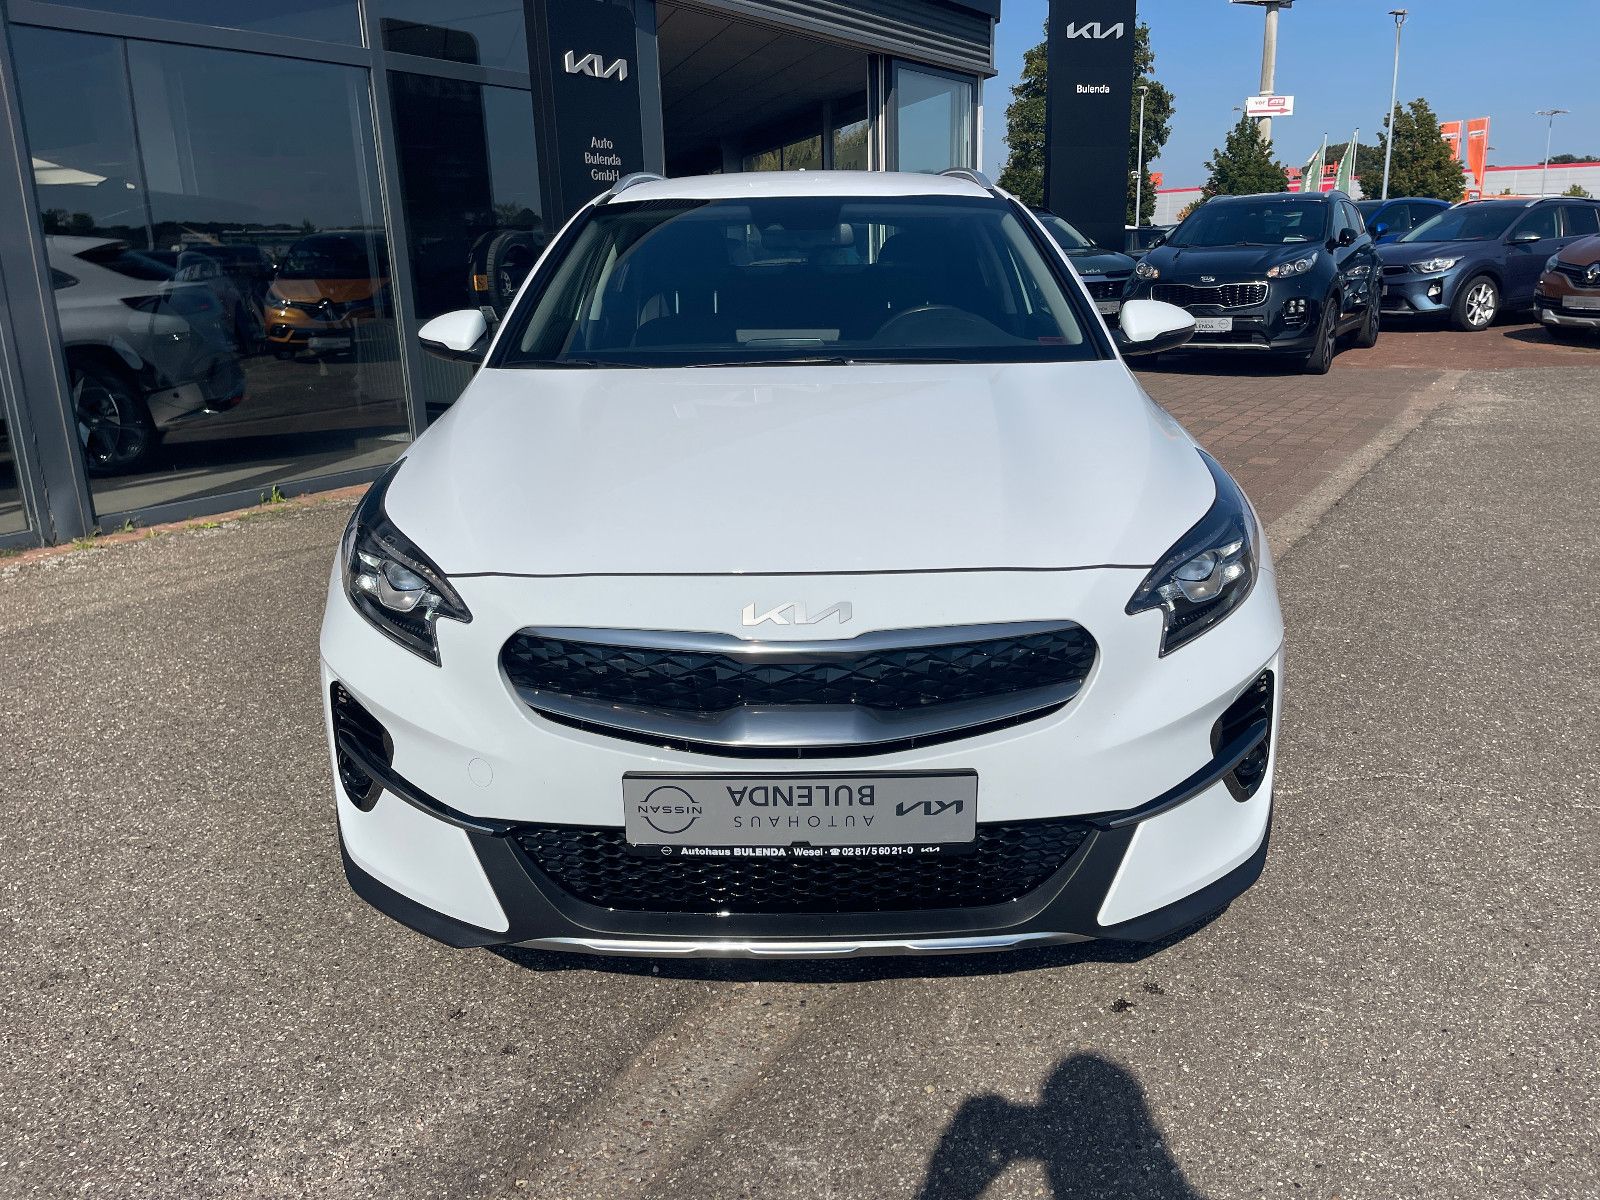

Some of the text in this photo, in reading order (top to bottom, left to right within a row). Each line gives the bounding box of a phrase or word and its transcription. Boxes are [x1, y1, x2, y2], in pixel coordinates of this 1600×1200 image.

[1066, 22, 1124, 39] KIA
[564, 50, 628, 81] KIA
[1076, 84, 1110, 94] Bulenda
[591, 137, 613, 149] Auto
[584, 152, 622, 166] Bulenda
[590, 169, 620, 182] GmbH
[741, 600, 853, 626] KIA
[726, 785, 875, 807] BULENDA
[637, 805, 703, 815] NISSAN
[896, 800, 964, 817] KIA
[734, 815, 875, 828] AUTOHAUS
[681, 847, 731, 856] Autohaus
[733, 847, 786, 857] BULENDA
[793, 847, 823, 856] Wesel
